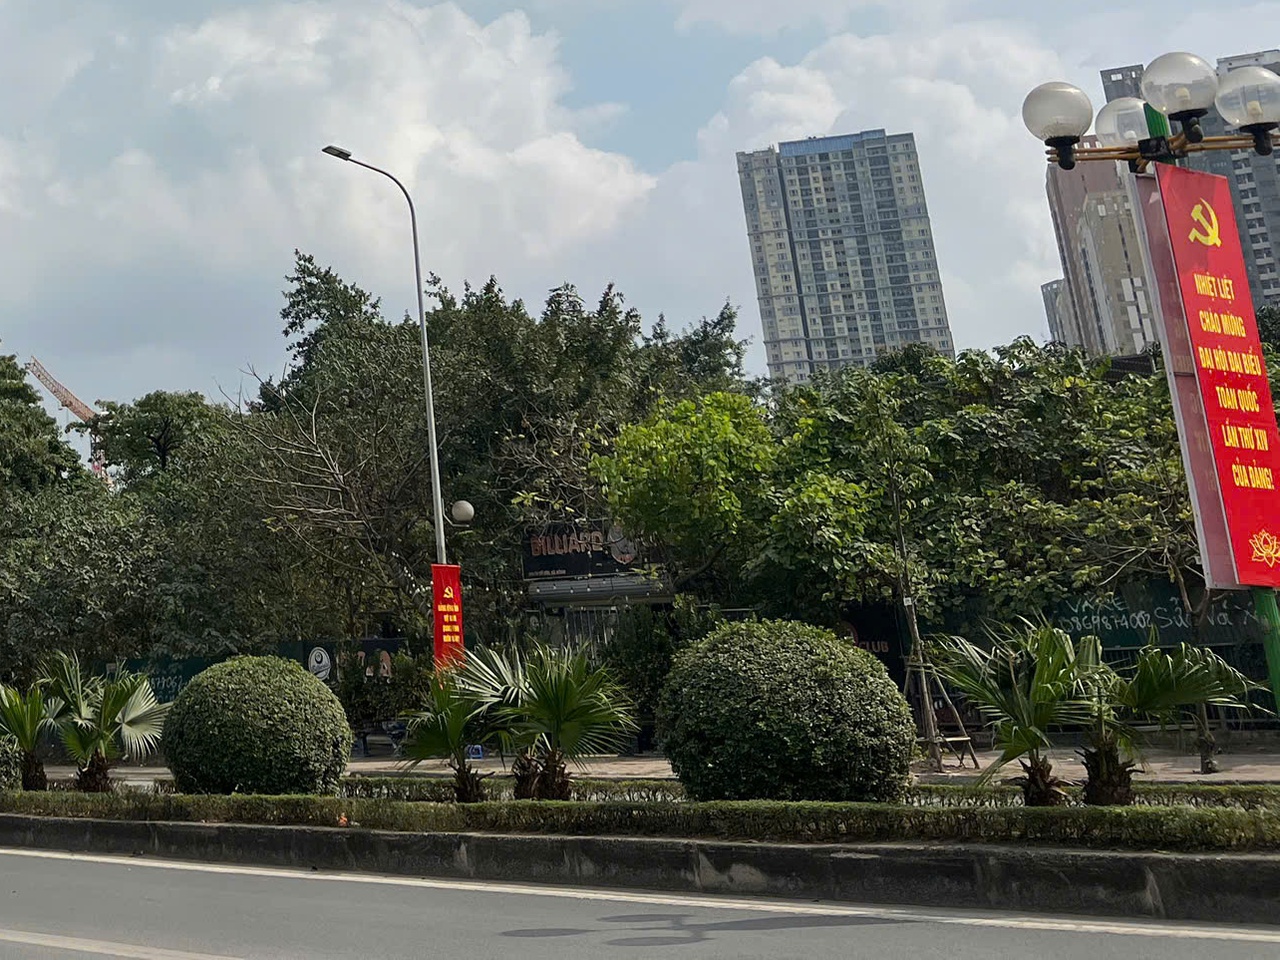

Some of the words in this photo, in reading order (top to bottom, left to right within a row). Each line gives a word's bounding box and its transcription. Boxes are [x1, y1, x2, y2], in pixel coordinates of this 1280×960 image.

[1193, 271, 1218, 301] NHIỆT
[1217, 274, 1235, 304] LIỆT
[1199, 307, 1222, 333] CHÀO
[1220, 310, 1246, 337] MỪNG
[1242, 345, 1262, 376] BIỂU
[1216, 382, 1238, 410] TOÀN
[1237, 383, 1260, 412] QUỐC
[1221, 417, 1240, 448] LẦN
[1237, 423, 1255, 450] THỨ
[1254, 428, 1269, 451] XIV
[1231, 456, 1250, 487] CỦA
